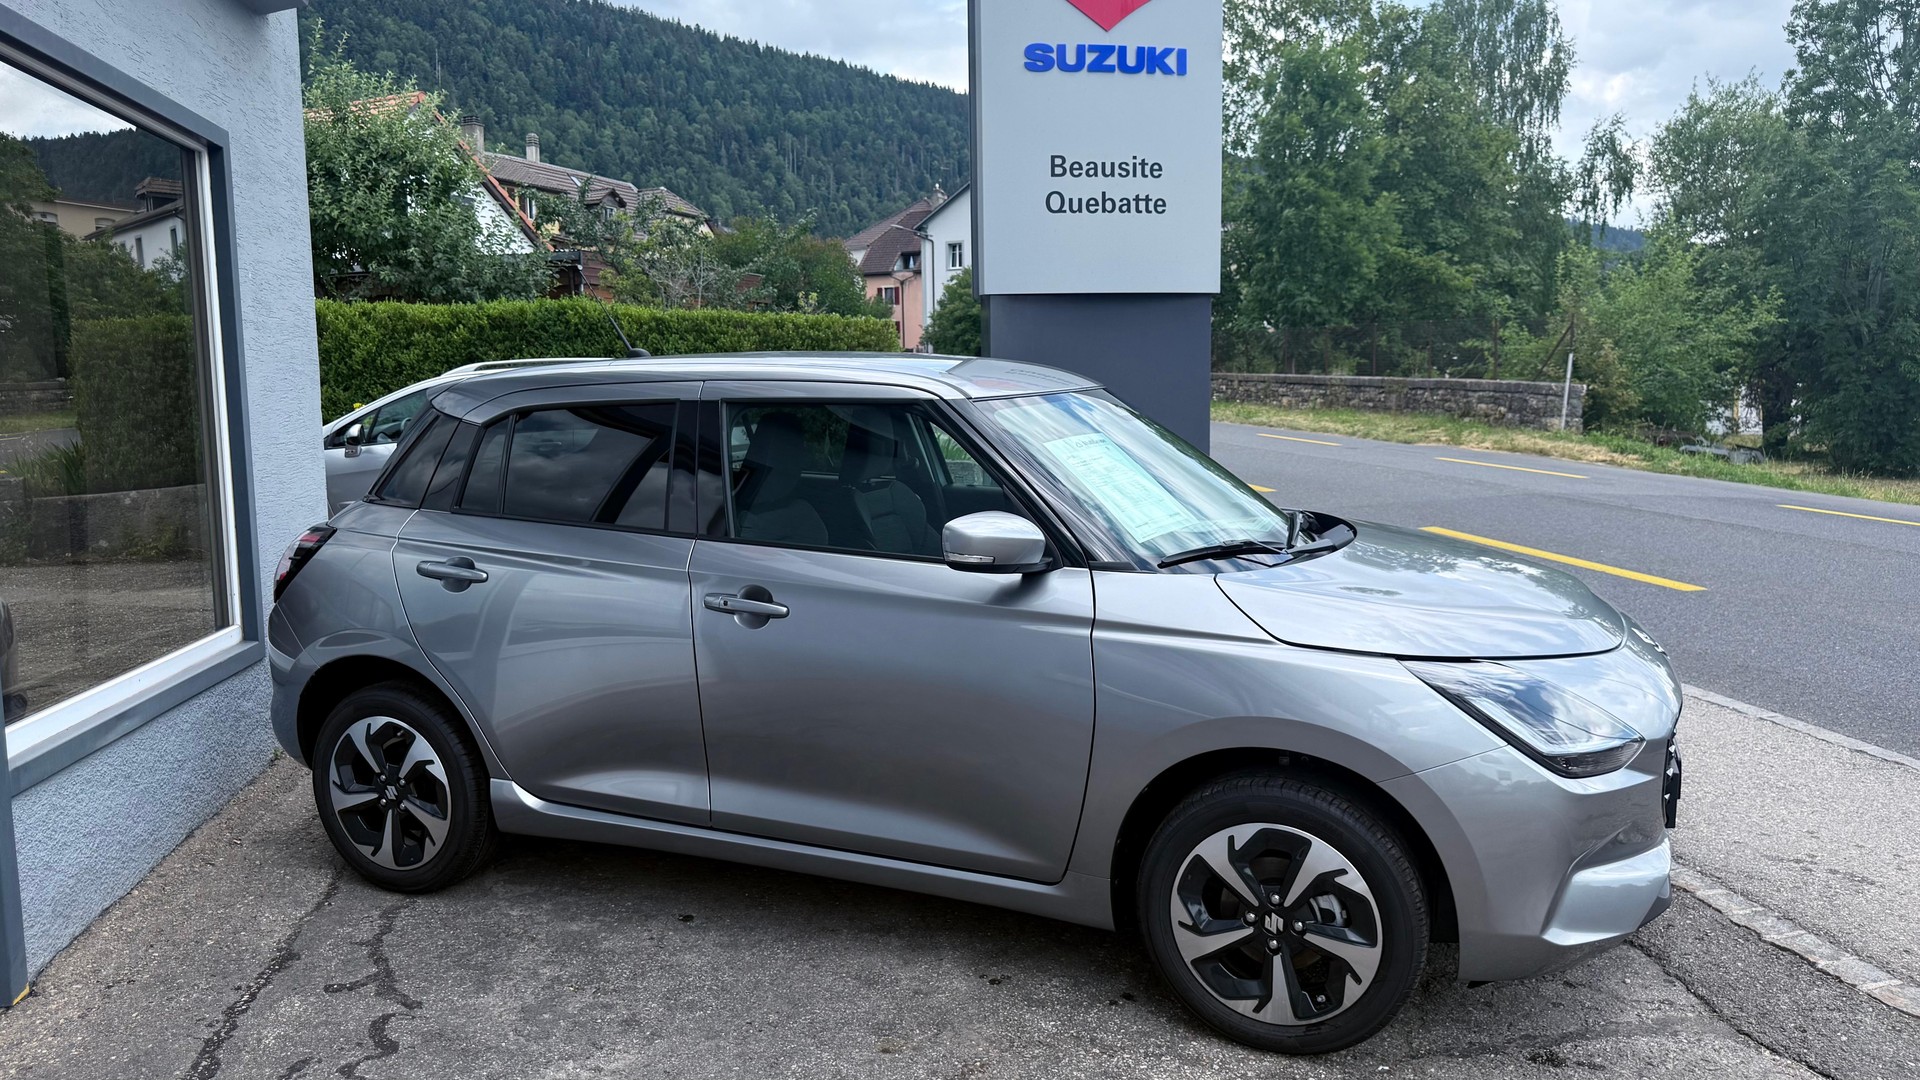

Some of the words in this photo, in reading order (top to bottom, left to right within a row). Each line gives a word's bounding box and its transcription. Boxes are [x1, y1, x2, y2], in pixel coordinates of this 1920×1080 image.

[1024, 43, 1187, 76] SUZUKI
[1050, 154, 1163, 178] Beausite
[1045, 190, 1167, 214] Quebatte
